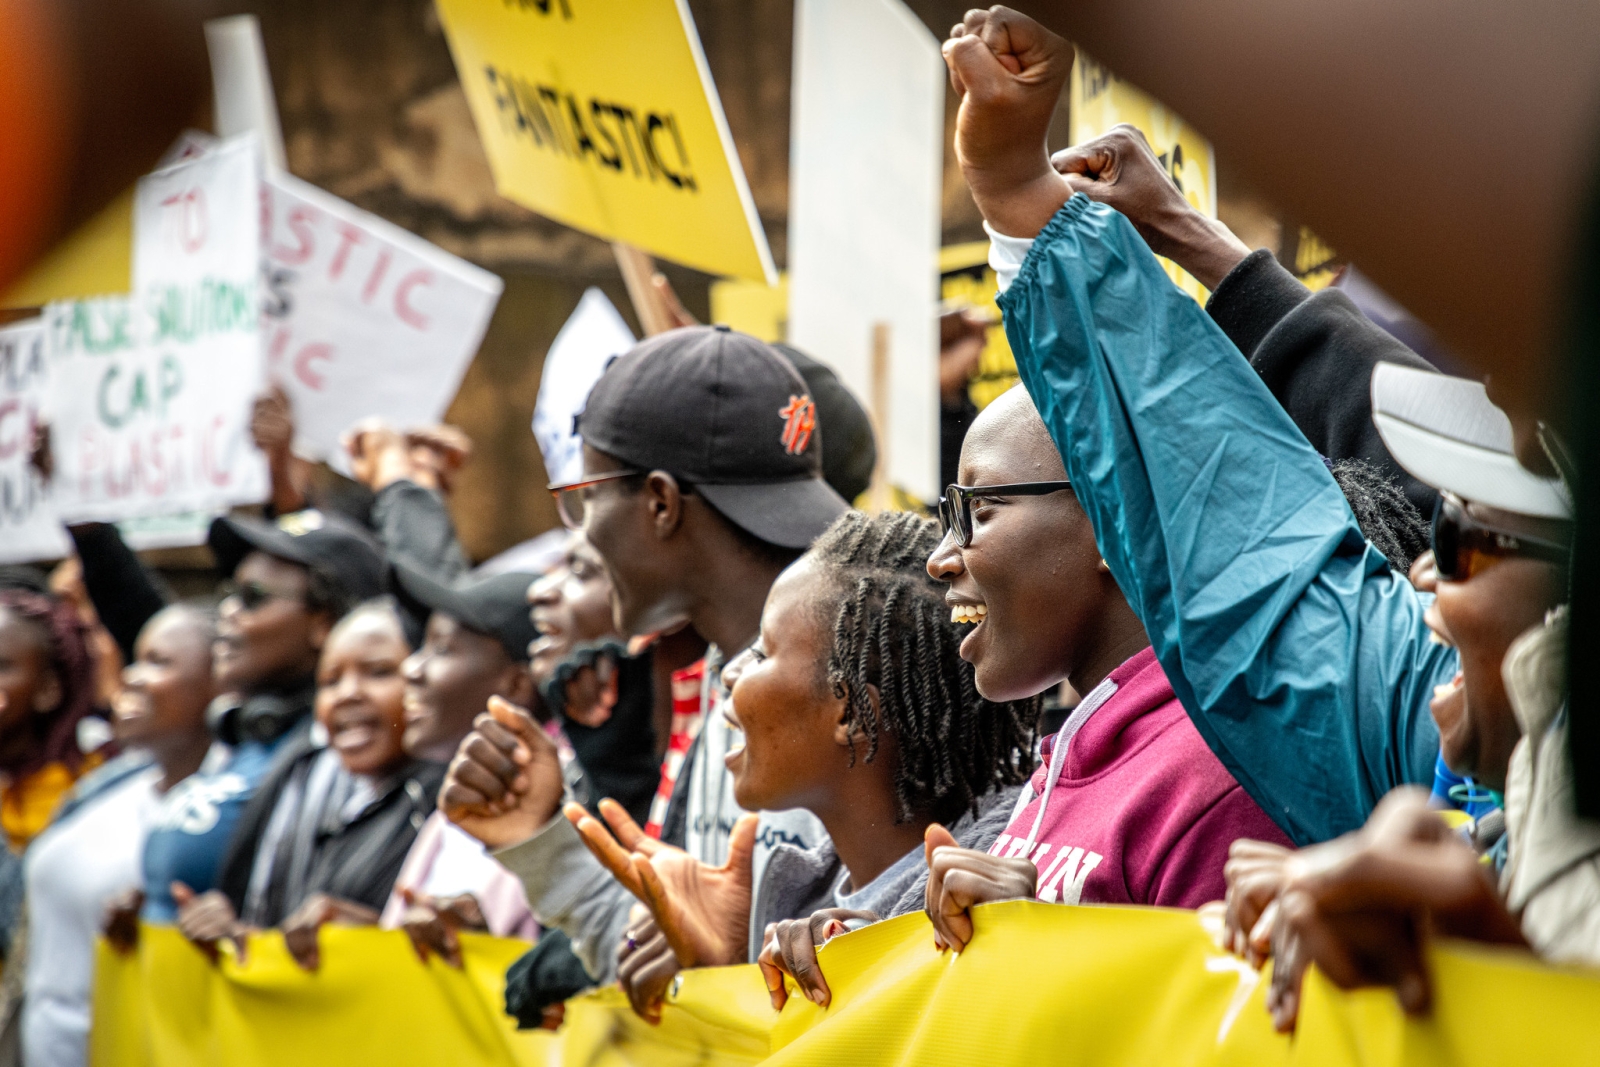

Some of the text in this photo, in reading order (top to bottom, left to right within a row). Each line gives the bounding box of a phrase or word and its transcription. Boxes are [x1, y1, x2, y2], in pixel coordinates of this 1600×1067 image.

[484, 64, 697, 192] FANTASTIC!
[160, 187, 209, 256] TO
[97, 355, 183, 433] CAP
